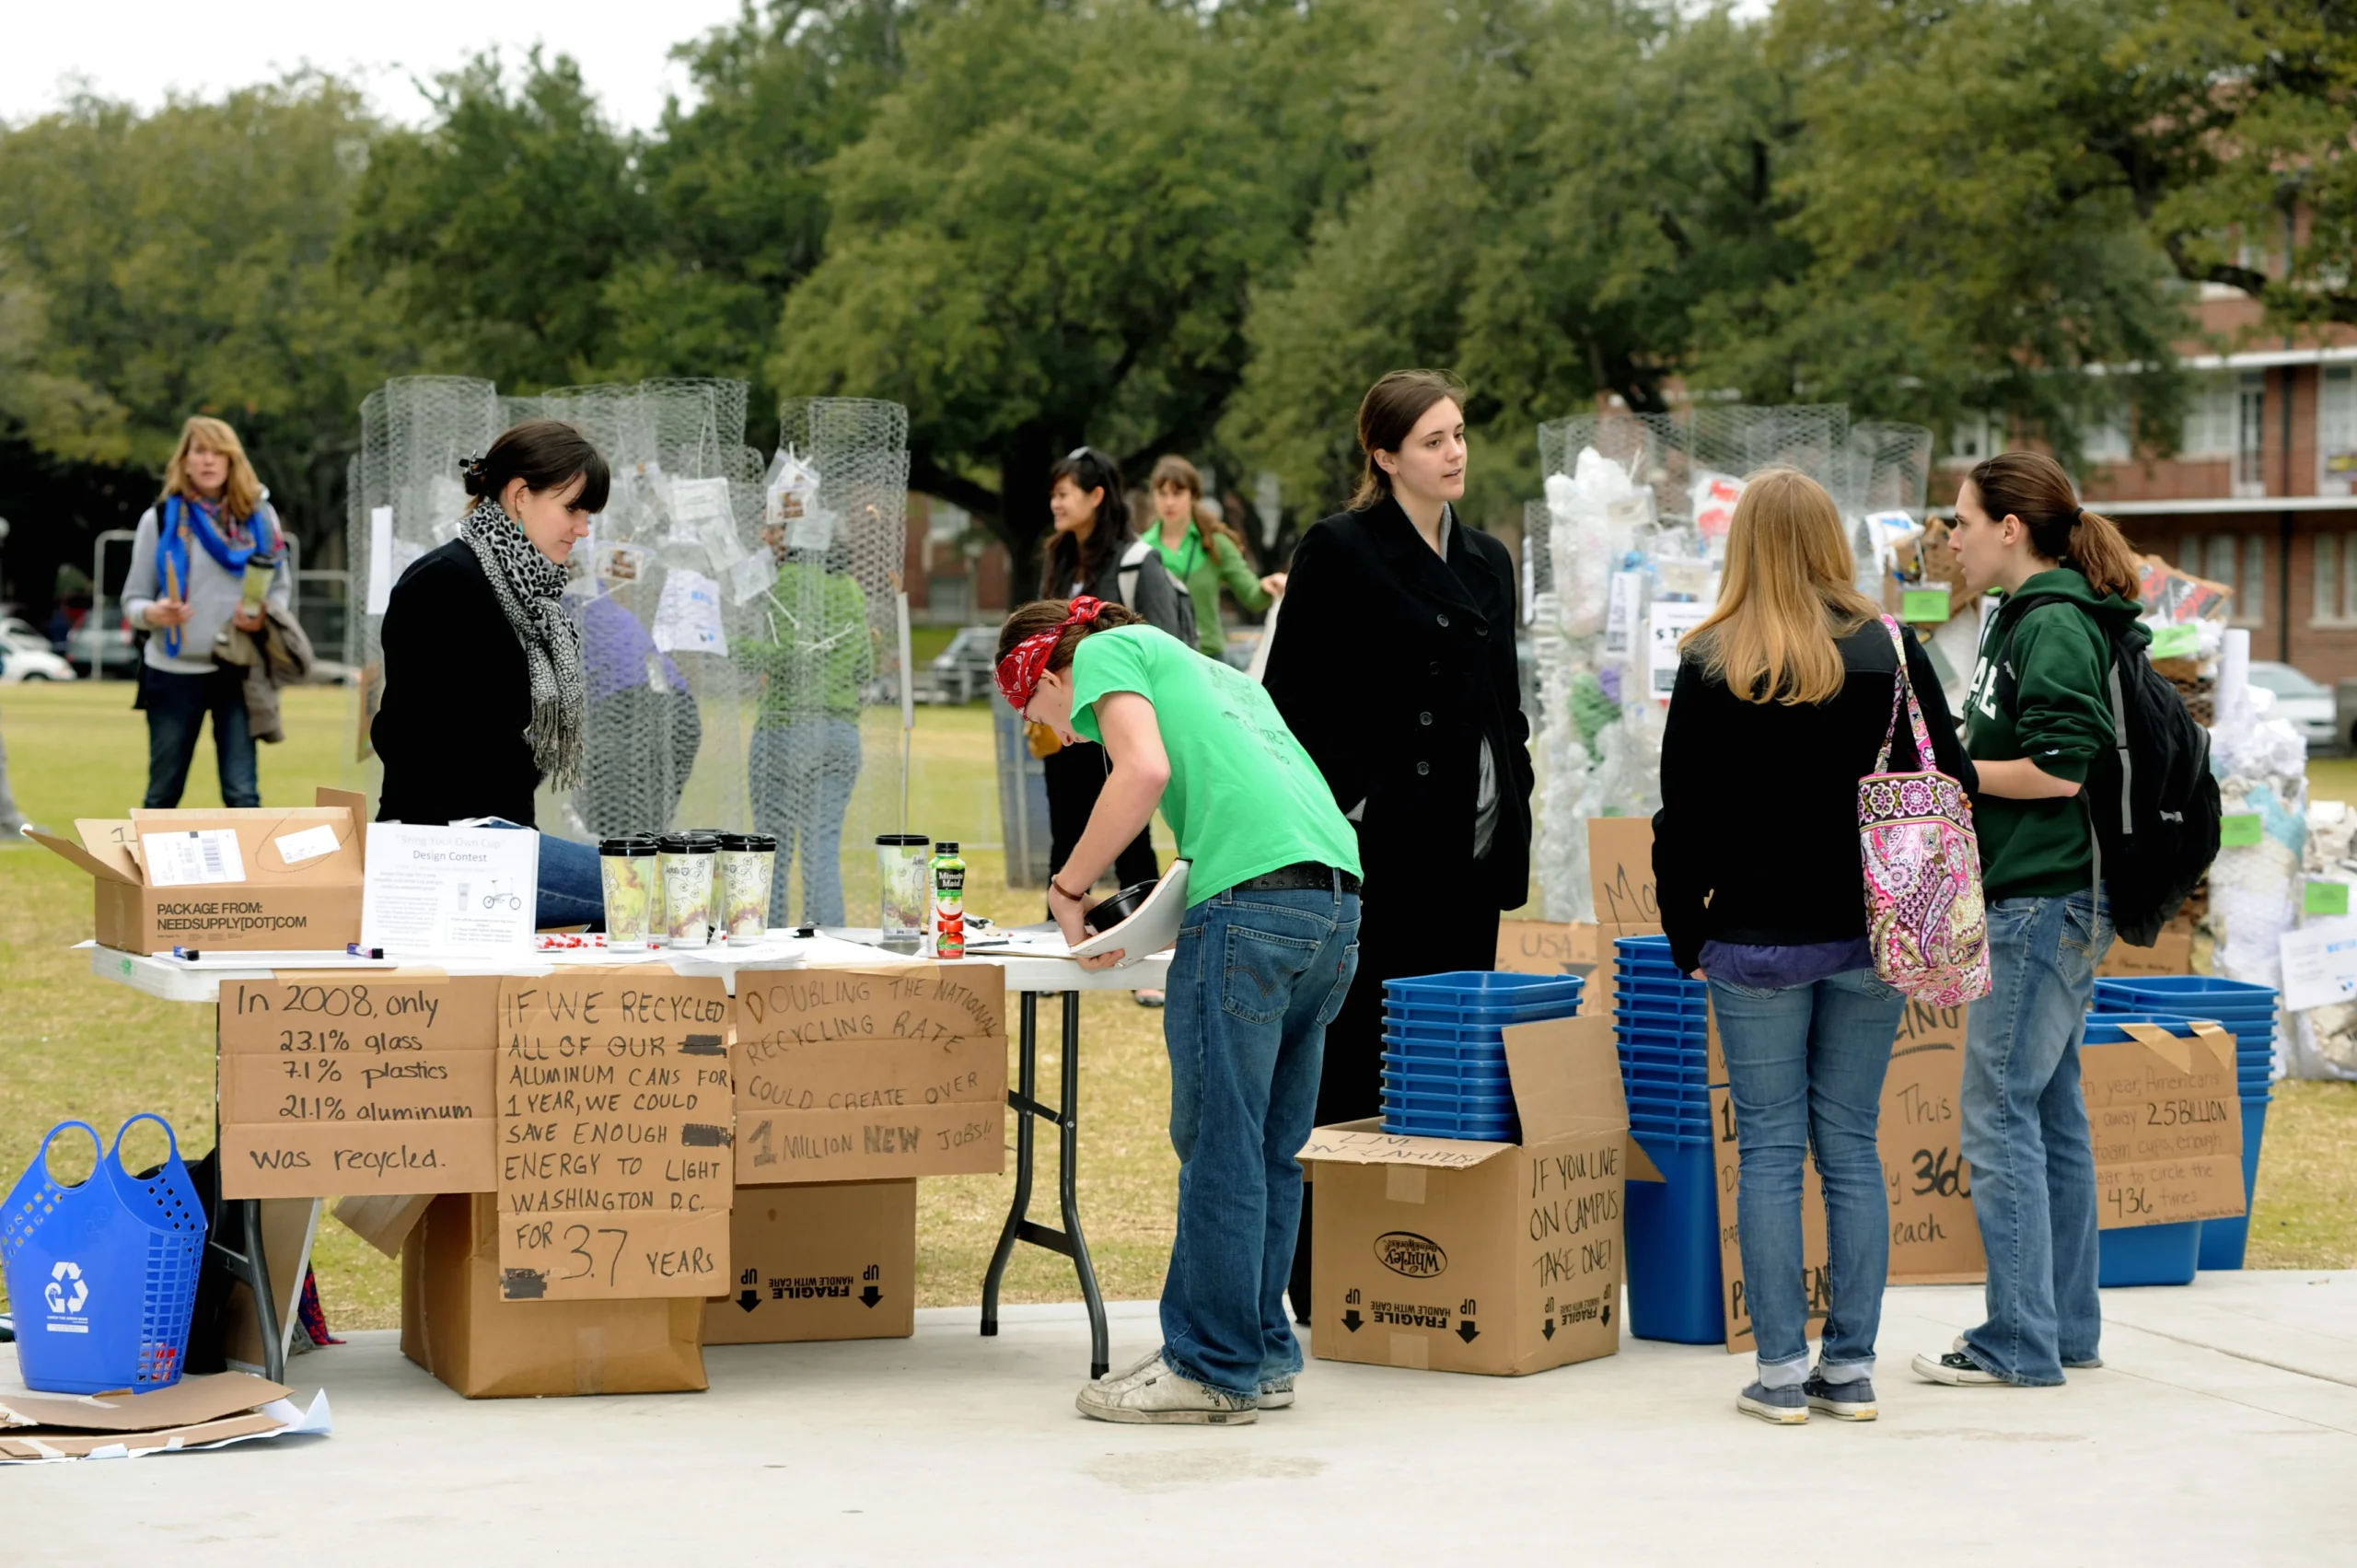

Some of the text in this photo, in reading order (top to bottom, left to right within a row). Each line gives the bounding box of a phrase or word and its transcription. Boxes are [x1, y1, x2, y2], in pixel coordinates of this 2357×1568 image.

[455, 837, 479, 848] Own
[412, 850, 487, 862] Design Contest
[157, 902, 262, 914] PACKAGE FROM:
[157, 916, 307, 931] NEEDSUPPLY[DOT]COM
[238, 984, 438, 1028] In 2008, only
[507, 990, 725, 1028] IF WE RECYCLED
[746, 978, 998, 1038] DOUBLING THE NATIONAL
[280, 1029, 423, 1054] 23.1% glass
[508, 1033, 666, 1060] ALL OF OUR
[747, 1010, 964, 1067] RECYCLING RATE
[283, 1059, 447, 1089] 7.1% plastics
[509, 1065, 728, 1087] ALUMINUM CANS FOR
[2145, 1065, 2221, 1094] Americans
[749, 1072, 978, 1110] COULD CREATE OVER
[1897, 1083, 1952, 1124] This
[279, 1095, 472, 1121] 21.1% aluminum
[505, 1095, 521, 1117] 1
[585, 1093, 621, 1111] WE
[633, 1094, 698, 1110] COULD
[505, 1122, 668, 1144] SAVE ENOUGH
[2103, 1110, 2138, 1136] away
[748, 1121, 777, 1167] 1
[783, 1134, 853, 1161] MILLION
[864, 1124, 921, 1155] NEW
[2093, 1135, 2131, 1160] foam
[250, 1145, 447, 1178] was recycled.
[505, 1152, 721, 1181] ENERGY TO LIGHT
[1532, 1146, 1619, 1199] IF YOU LIVE
[511, 1188, 704, 1215] WASHINGTON D.C.
[2107, 1187, 2153, 1218] 436
[1530, 1189, 1619, 1241] ON CAMPUS
[1893, 1213, 1946, 1245] each
[517, 1221, 714, 1287] FOR 3.7 YEARS
[1384, 1249, 1440, 1273] Whirley
[740, 1269, 757, 1284] UP
[863, 1264, 879, 1280] UP
[1532, 1248, 1576, 1288] TAKE
[769, 1276, 853, 1287] HANDLE WITH CARE
[772, 1285, 850, 1299] FRAGILE
[1345, 1288, 1360, 1305] UP
[1370, 1301, 1450, 1317] HANDLE WITH CARE
[1460, 1298, 1476, 1315] UP
[1374, 1311, 1446, 1329] FRAGILE
[1562, 1307, 1597, 1326] FRAGILE
